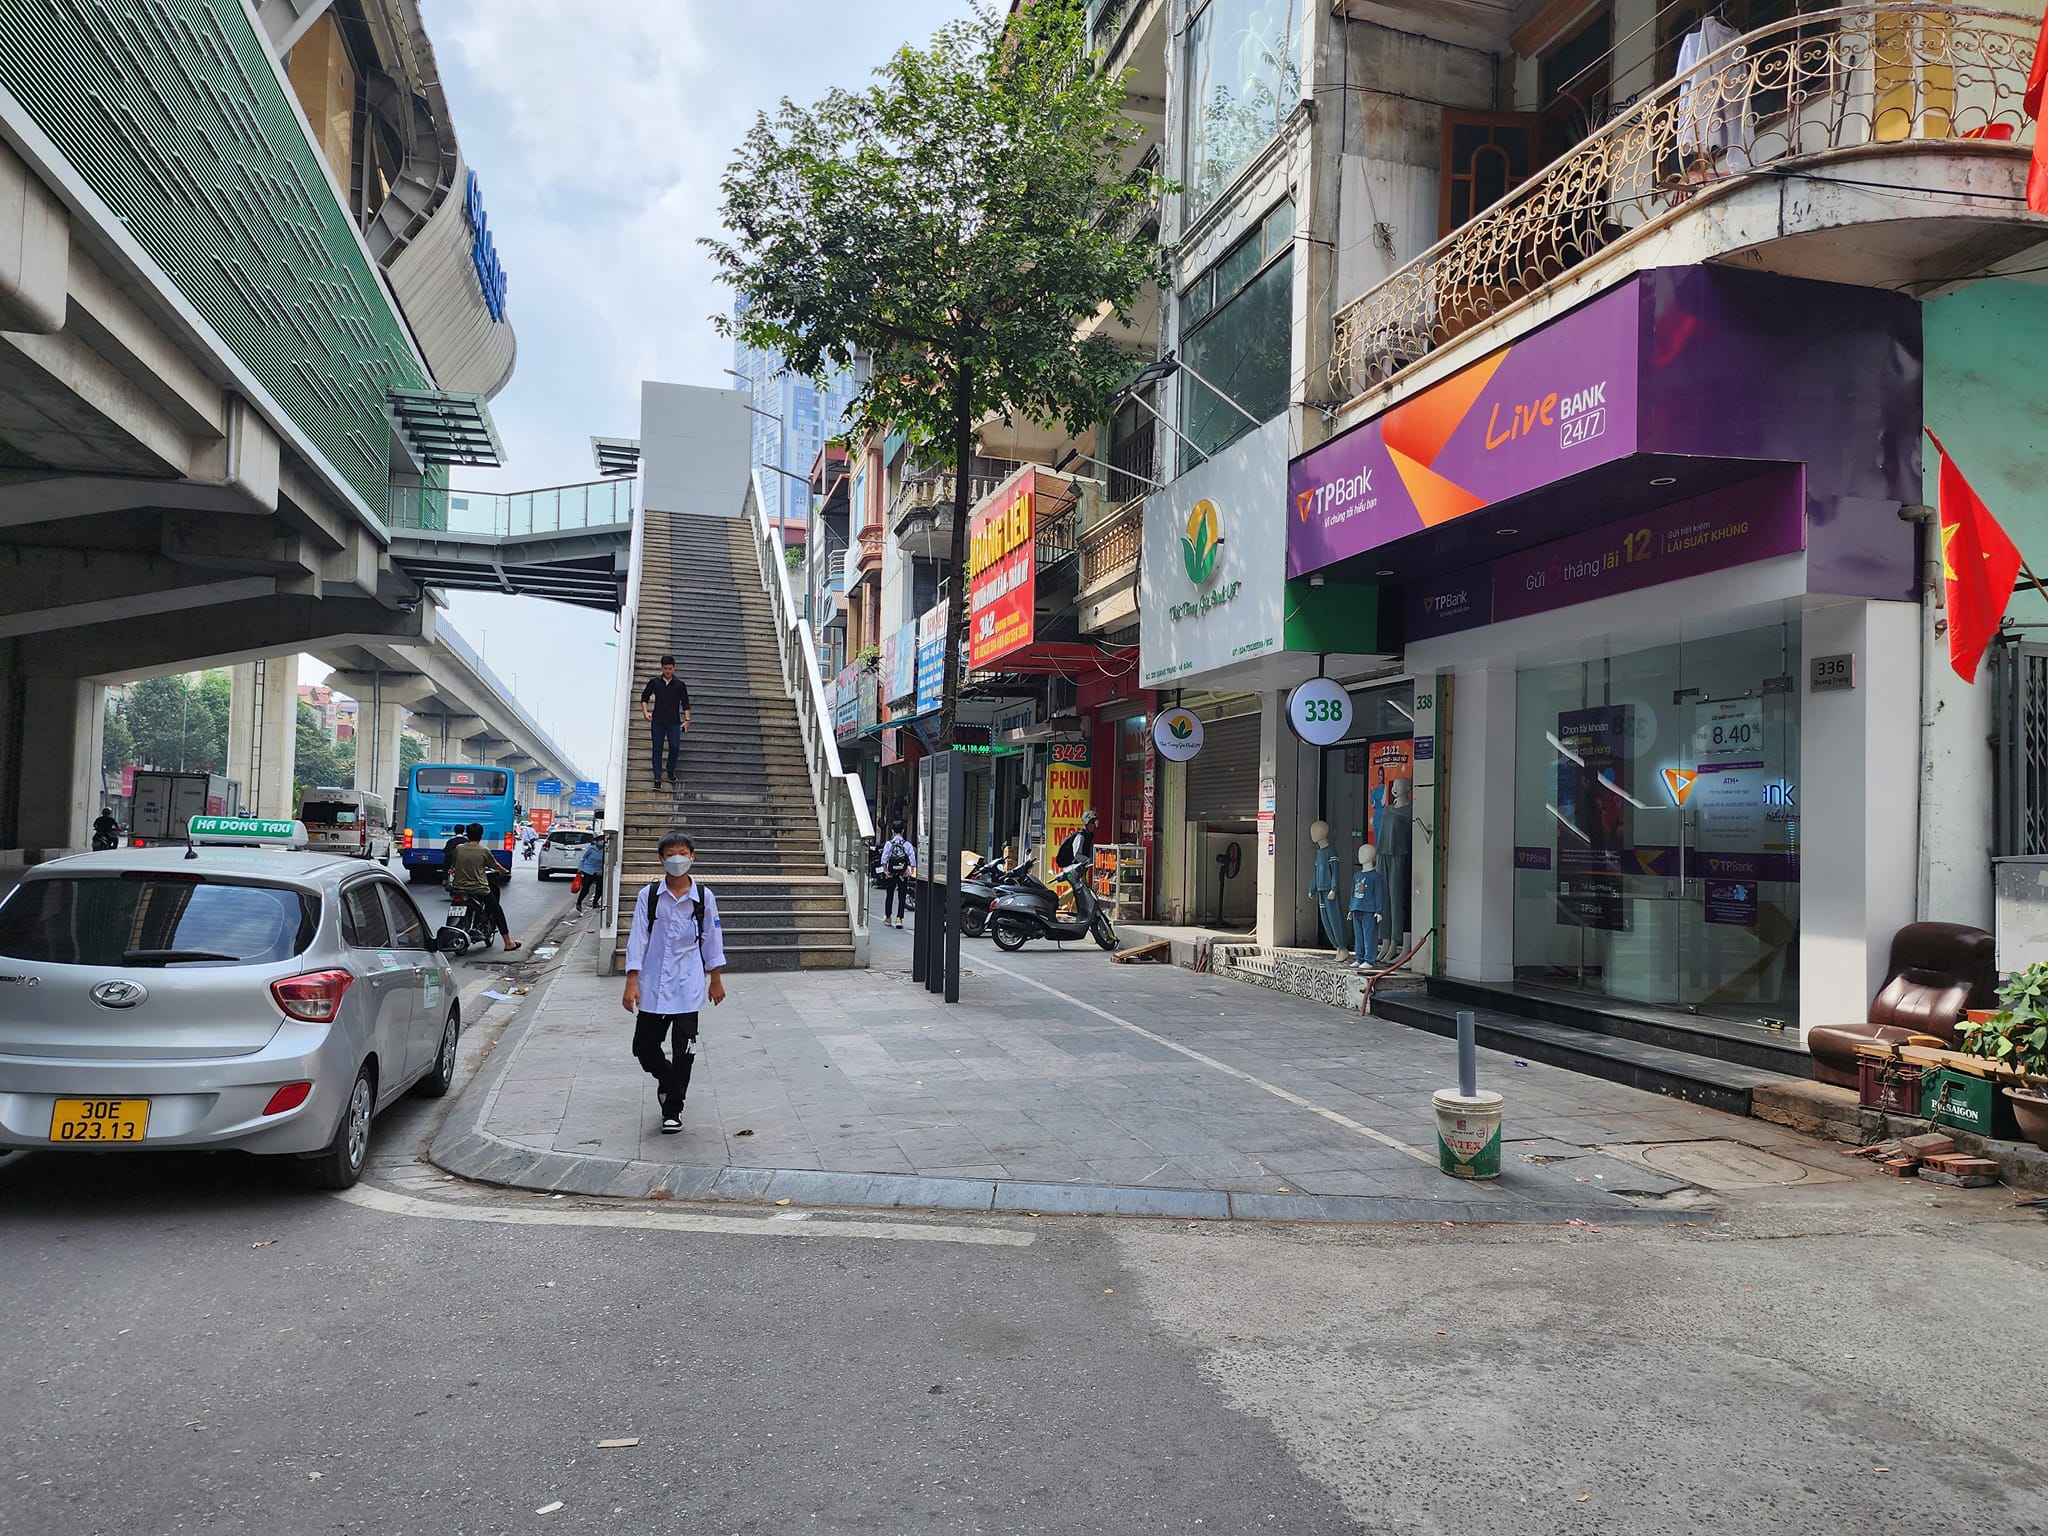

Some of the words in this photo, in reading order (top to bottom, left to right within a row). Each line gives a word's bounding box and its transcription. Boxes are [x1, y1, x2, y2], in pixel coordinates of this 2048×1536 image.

[1485, 392, 1557, 450] Live
[1560, 381, 1606, 420] BANK
[1562, 411, 1601, 447] 24/7
[1315, 465, 1373, 515] TPBank
[1526, 571, 1545, 591] Gửi
[1563, 559, 1600, 581] tháng
[1603, 550, 1620, 571] lãi
[1623, 528, 1653, 564] 12
[1435, 589, 1468, 611] TPBank
[1817, 659, 1845, 676] 336
[1304, 699, 1343, 722] 338
[1416, 694, 1433, 711] 338
[1052, 744, 1087, 761] 342
[1049, 770, 1089, 789] PHUN
[1051, 795, 1084, 818] XĂM
[262, 823, 291, 833] TAXI
[1720, 860, 1753, 872] TPBank
[81, 1101, 122, 1120] 30E
[1945, 1103, 1979, 1120] SAIGON
[61, 1122, 135, 1140] 023.13
